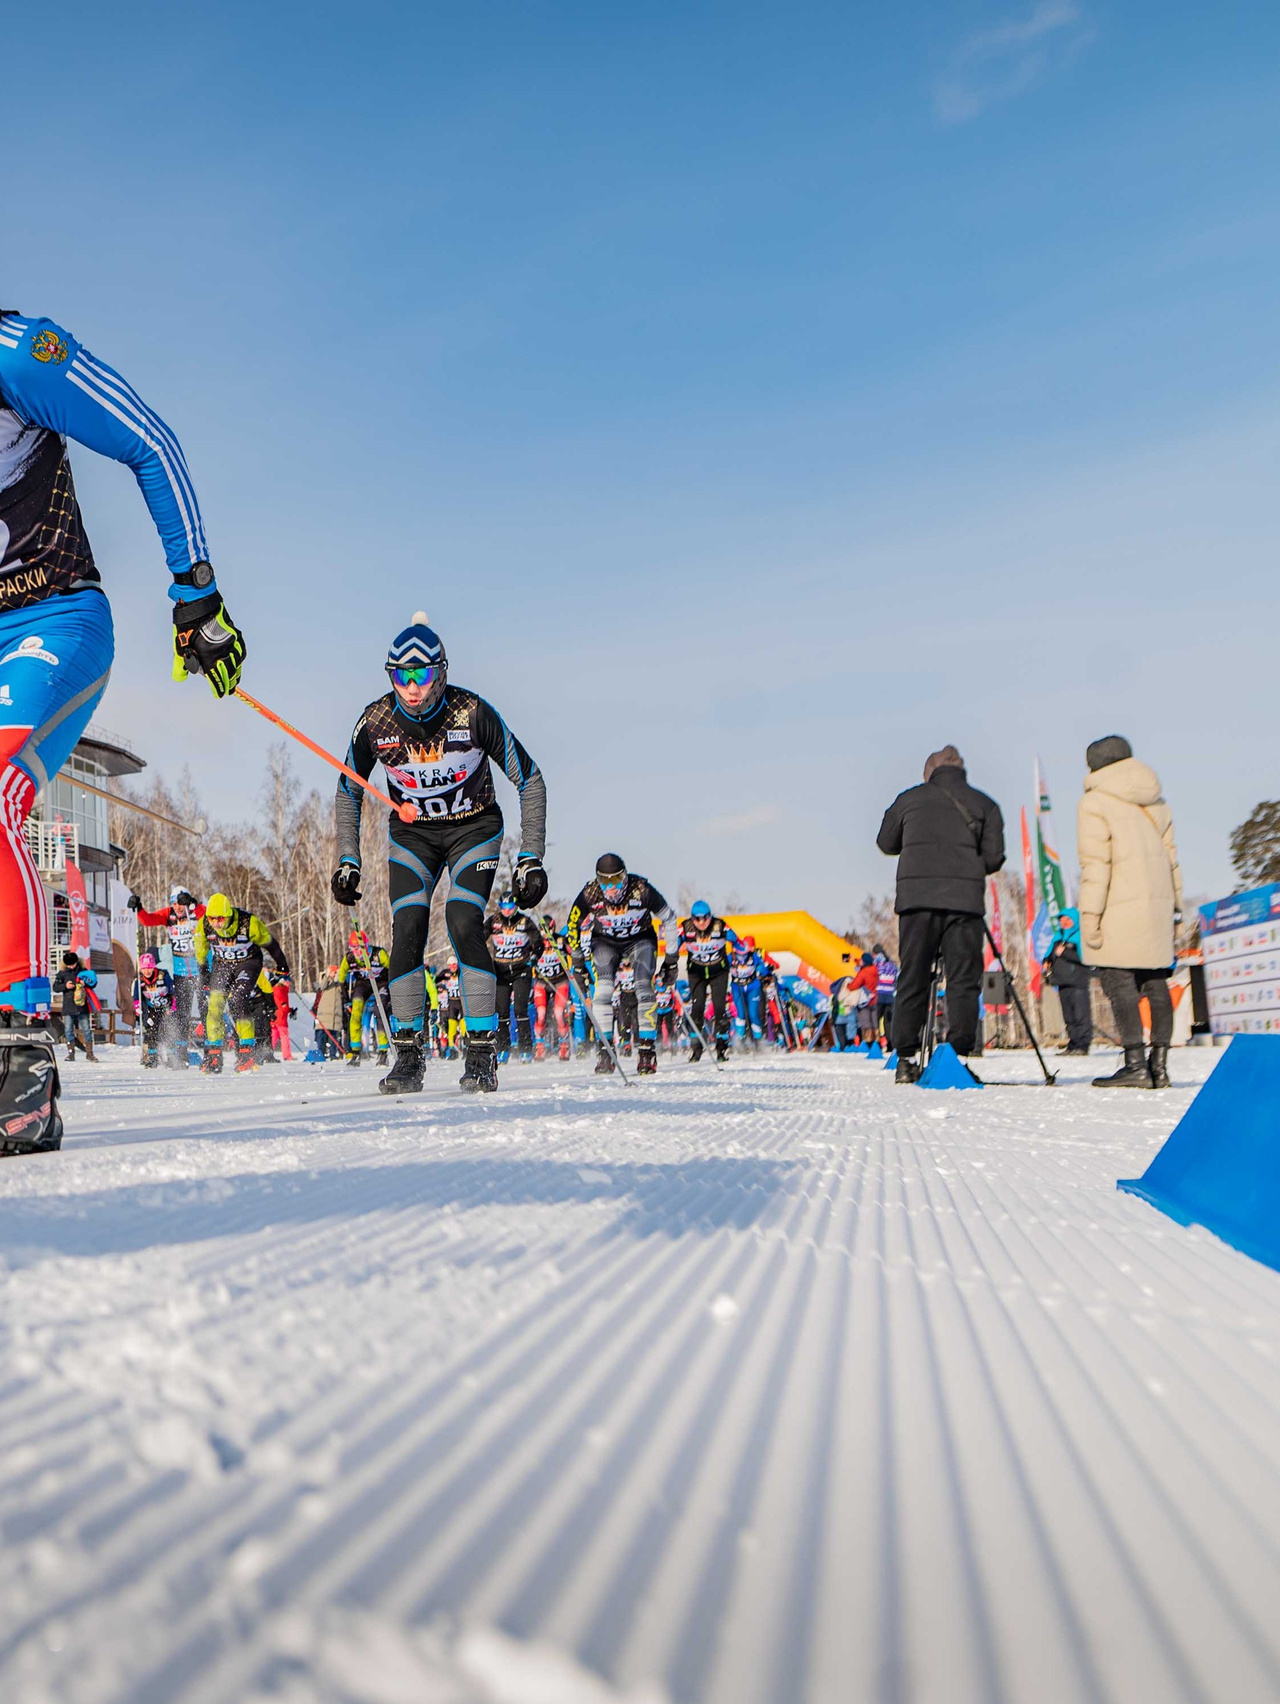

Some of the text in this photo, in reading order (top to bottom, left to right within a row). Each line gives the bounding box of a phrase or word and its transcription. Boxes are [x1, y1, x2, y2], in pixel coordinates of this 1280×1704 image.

[419, 763, 467, 778] KRAS
[421, 770, 468, 789] LAND
[495, 948, 523, 958] 222
[539, 966, 561, 977] 231
[5, 1101, 52, 1136] SPINE
